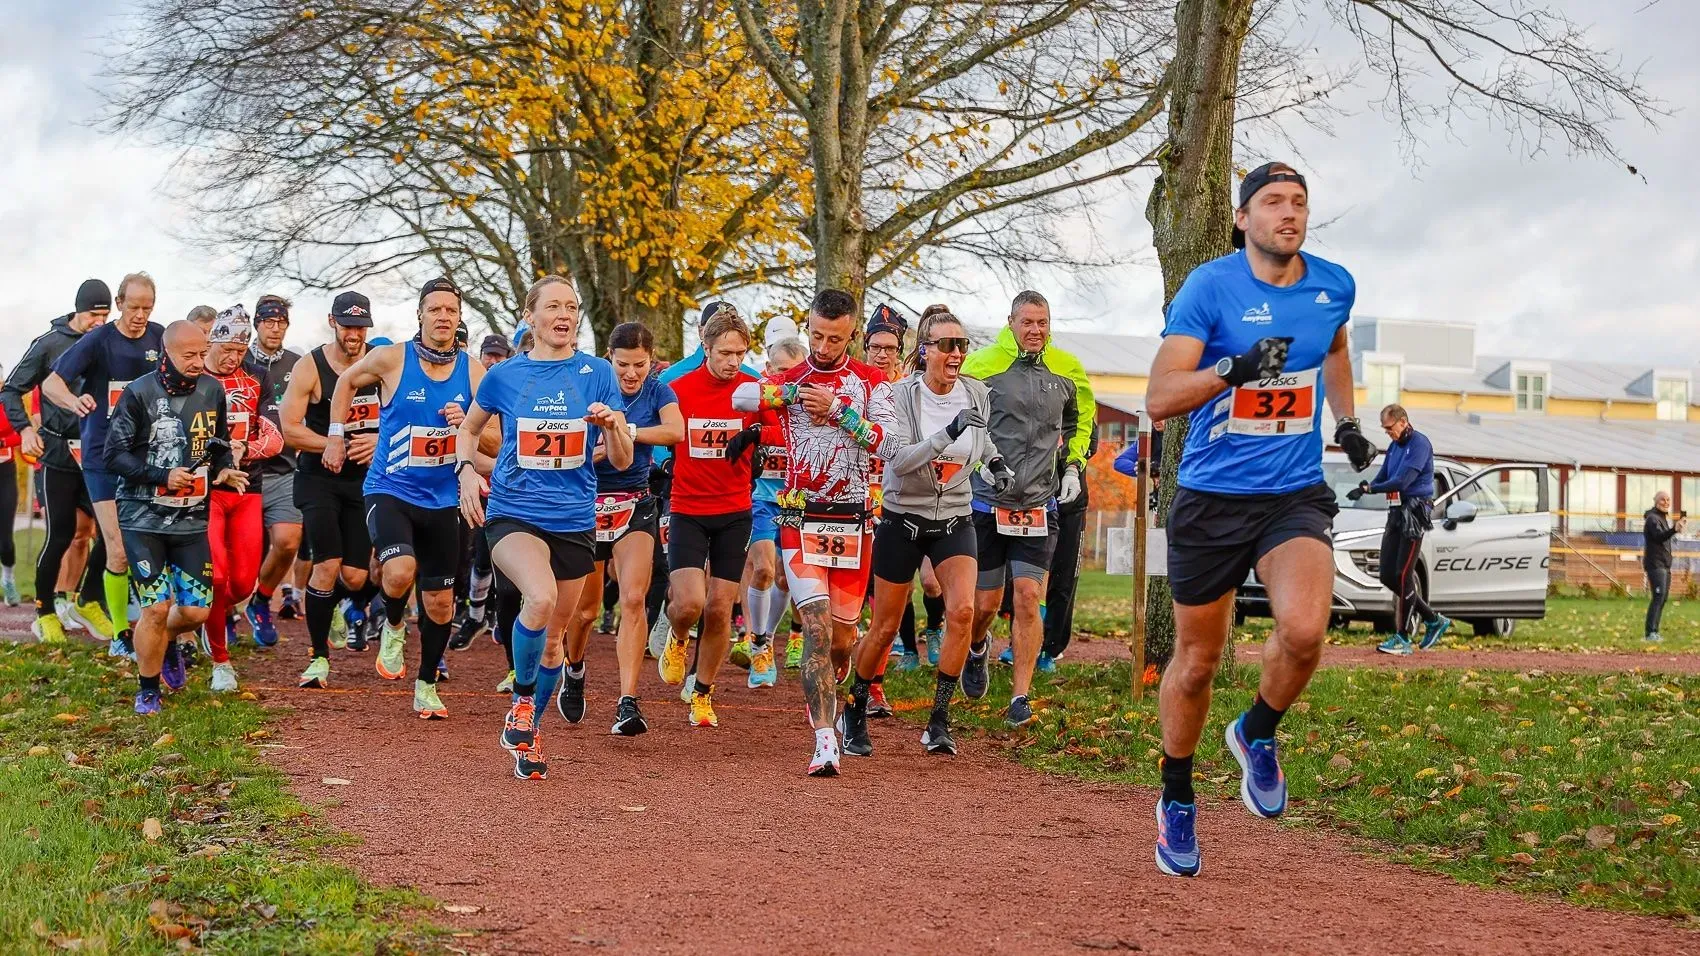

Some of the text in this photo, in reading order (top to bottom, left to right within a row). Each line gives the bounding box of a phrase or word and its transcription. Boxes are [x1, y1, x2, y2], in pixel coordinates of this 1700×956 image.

[532, 405, 568, 413] AnyPace
[1253, 391, 1296, 418] 32
[346, 405, 369, 422] 29
[190, 411, 217, 438] 45
[547, 422, 569, 430] asics
[424, 438, 448, 456] 61
[535, 433, 566, 456] 21
[701, 430, 729, 448] 44
[1008, 510, 1034, 526] 65
[826, 525, 845, 533] asics
[816, 535, 845, 555] 38
[1434, 556, 1533, 572] ECLIPSE
